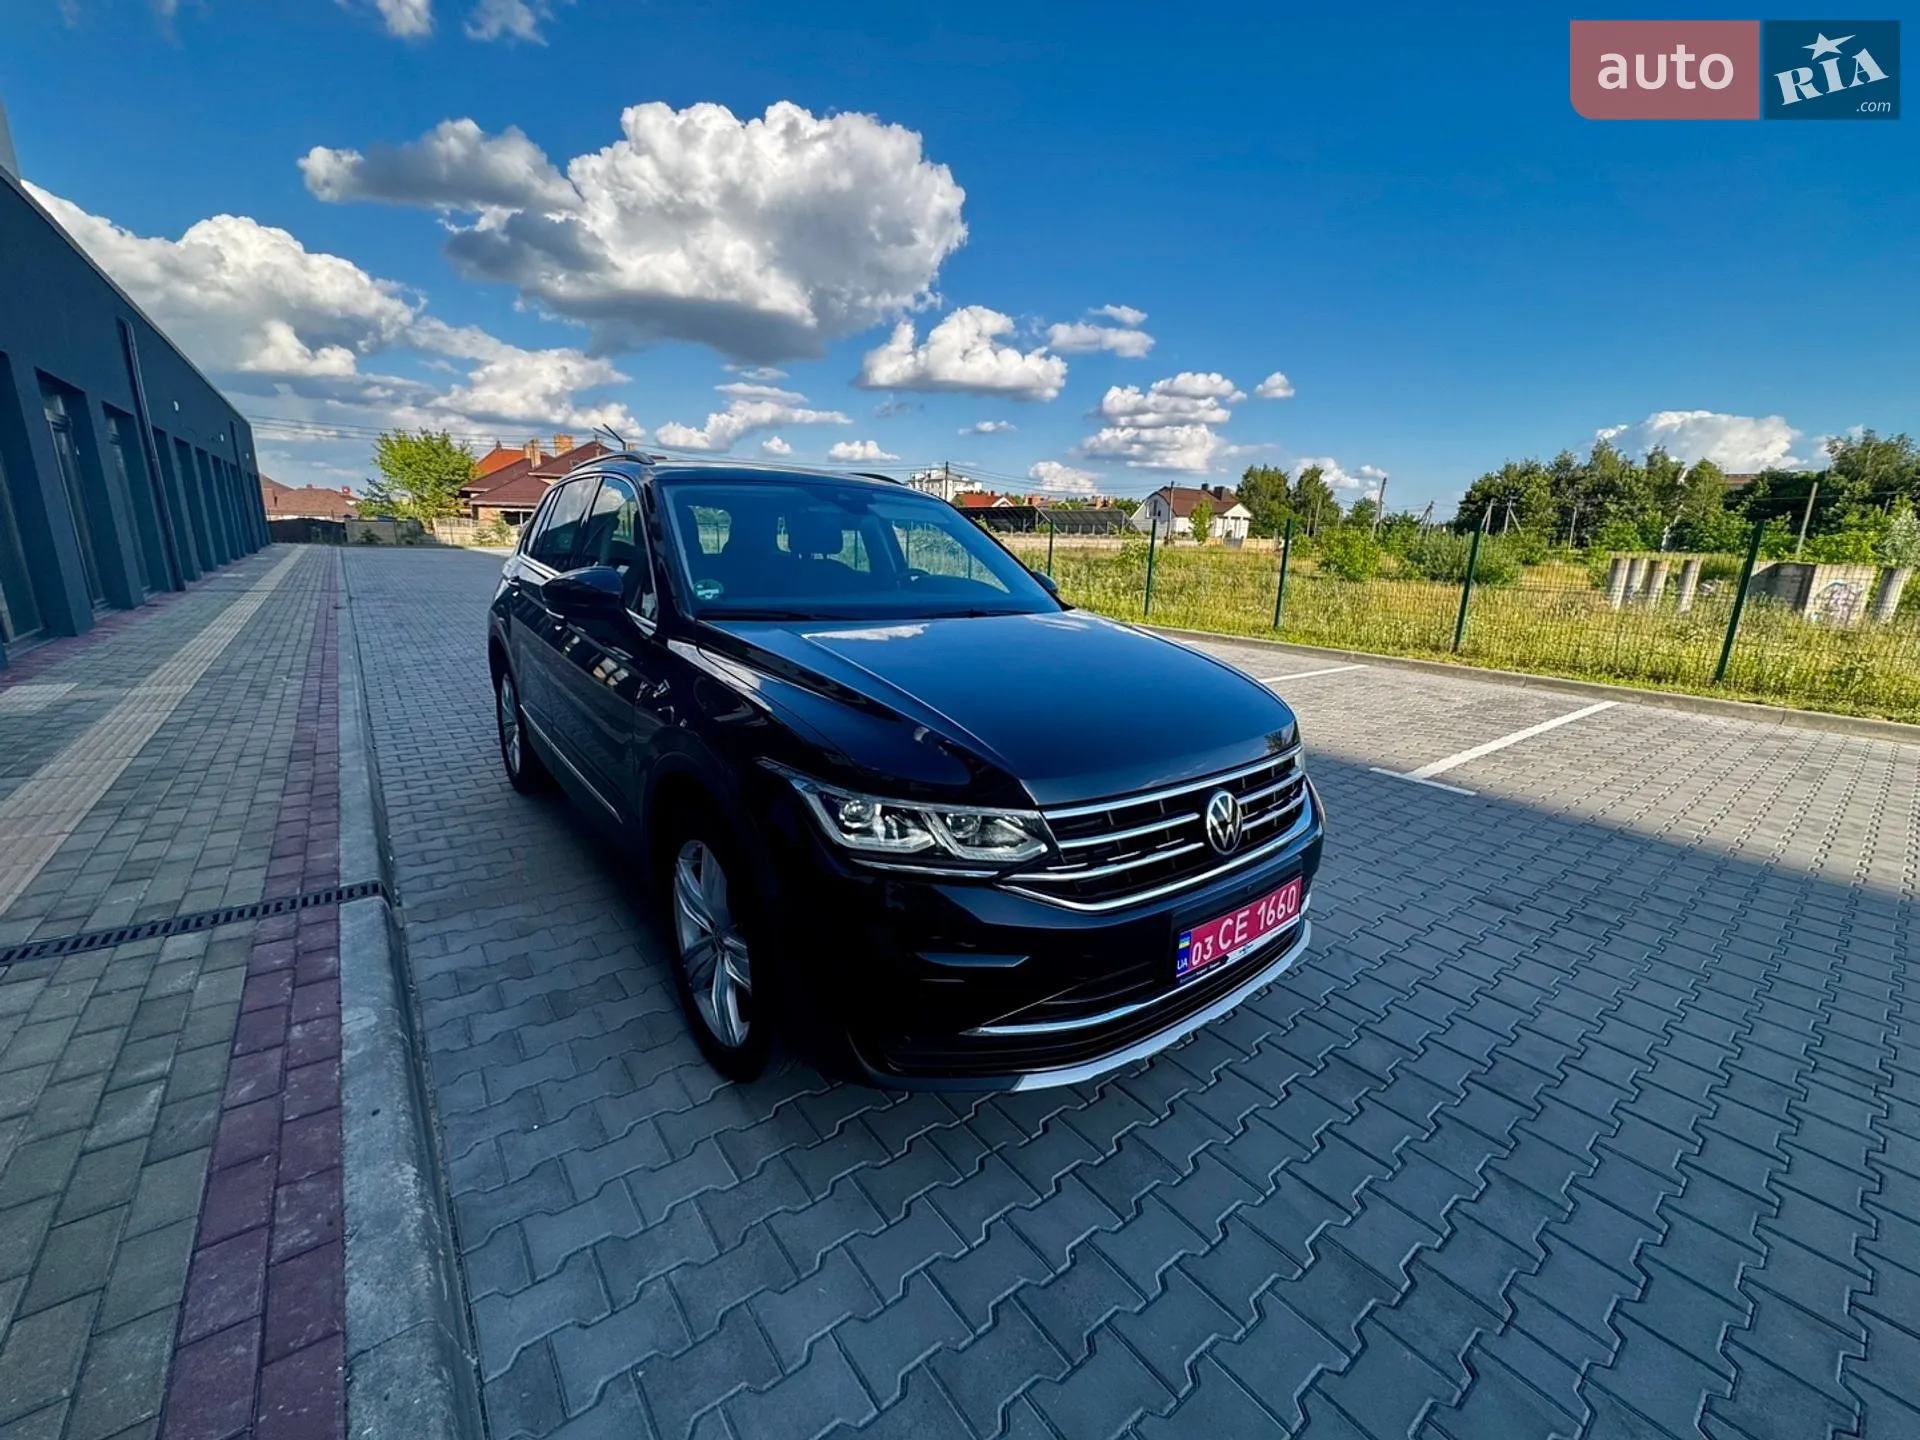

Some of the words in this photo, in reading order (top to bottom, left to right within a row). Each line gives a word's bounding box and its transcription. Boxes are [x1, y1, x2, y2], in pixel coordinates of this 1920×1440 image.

[1191, 935, 1214, 966] 03
[1218, 909, 1250, 950] CE
[1257, 885, 1296, 931] 1660
[1177, 957, 1188, 970] UA
